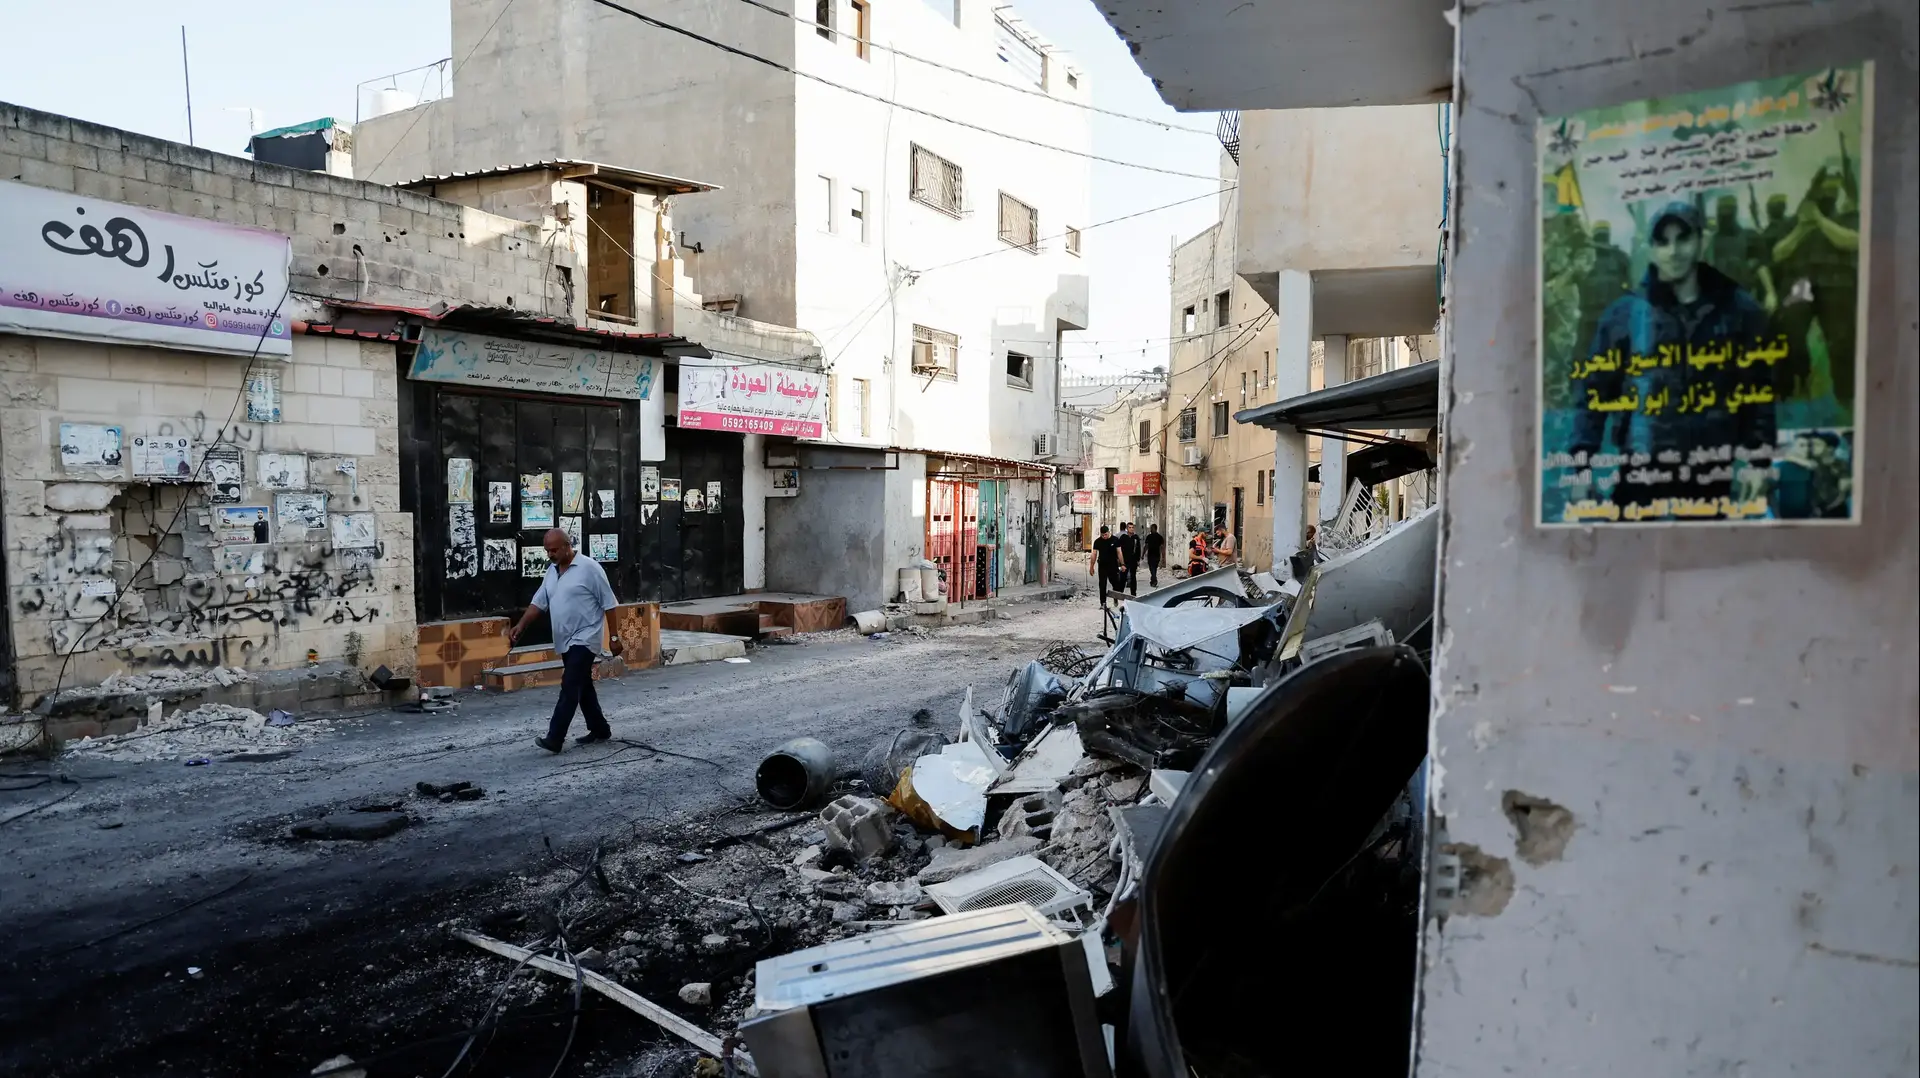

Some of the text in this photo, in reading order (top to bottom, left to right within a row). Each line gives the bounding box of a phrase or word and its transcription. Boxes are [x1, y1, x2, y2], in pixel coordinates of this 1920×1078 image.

[42, 207, 175, 283] رهف
[1570, 348, 1622, 379] المحرر
[731, 365, 772, 397] العودة
[1677, 381, 1716, 412] نزار
[1643, 386, 1669, 416] ابو
[1727, 383, 1774, 414] عدي
[722, 416, 774, 432] 0592165409
